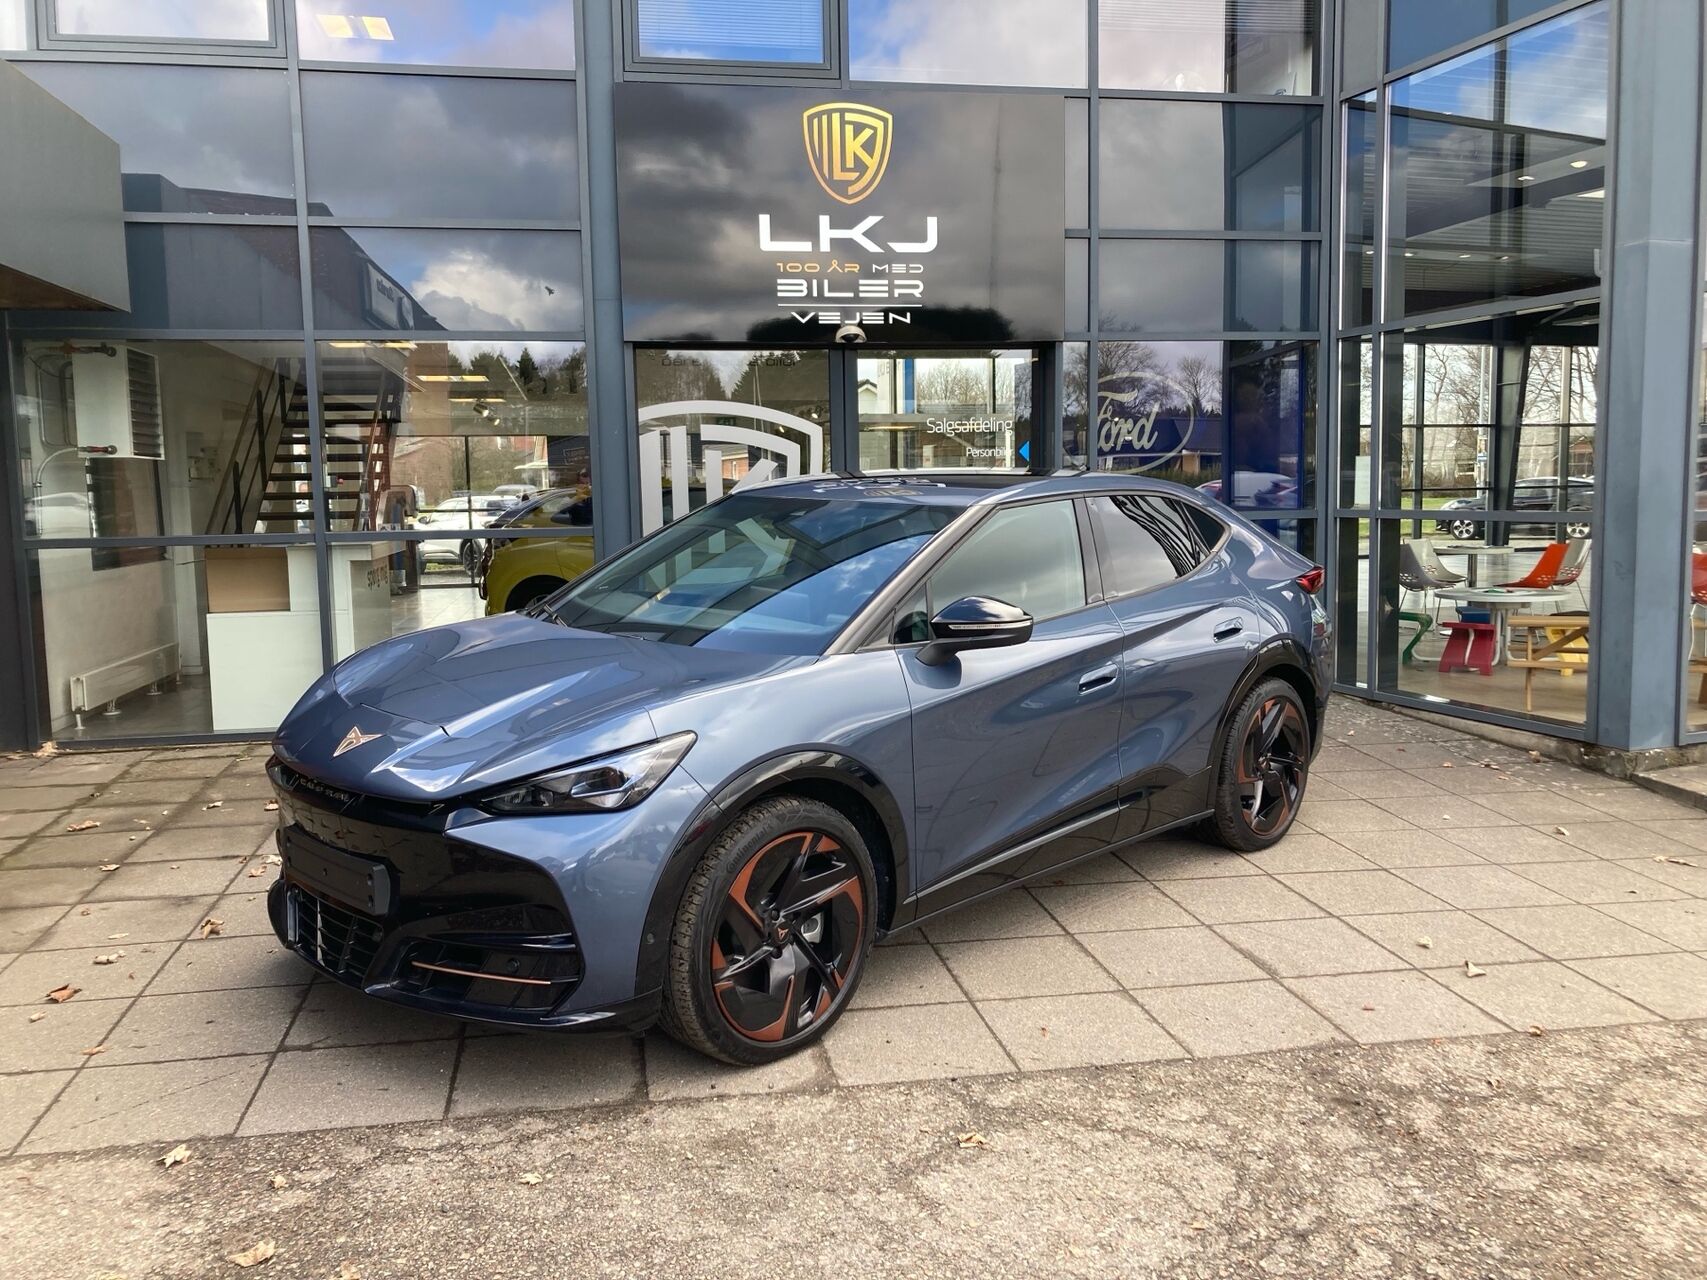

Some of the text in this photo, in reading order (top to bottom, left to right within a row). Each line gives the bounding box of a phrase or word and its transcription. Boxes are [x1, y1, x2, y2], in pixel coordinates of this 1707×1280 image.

[758, 213, 939, 254] LKJ
[776, 262, 820, 274] 100
[872, 263, 924, 274] MED
[776, 278, 924, 299] BILER
[790, 311, 912, 325] VEJEN
[926, 417, 1014, 437] Salgsafdeling
